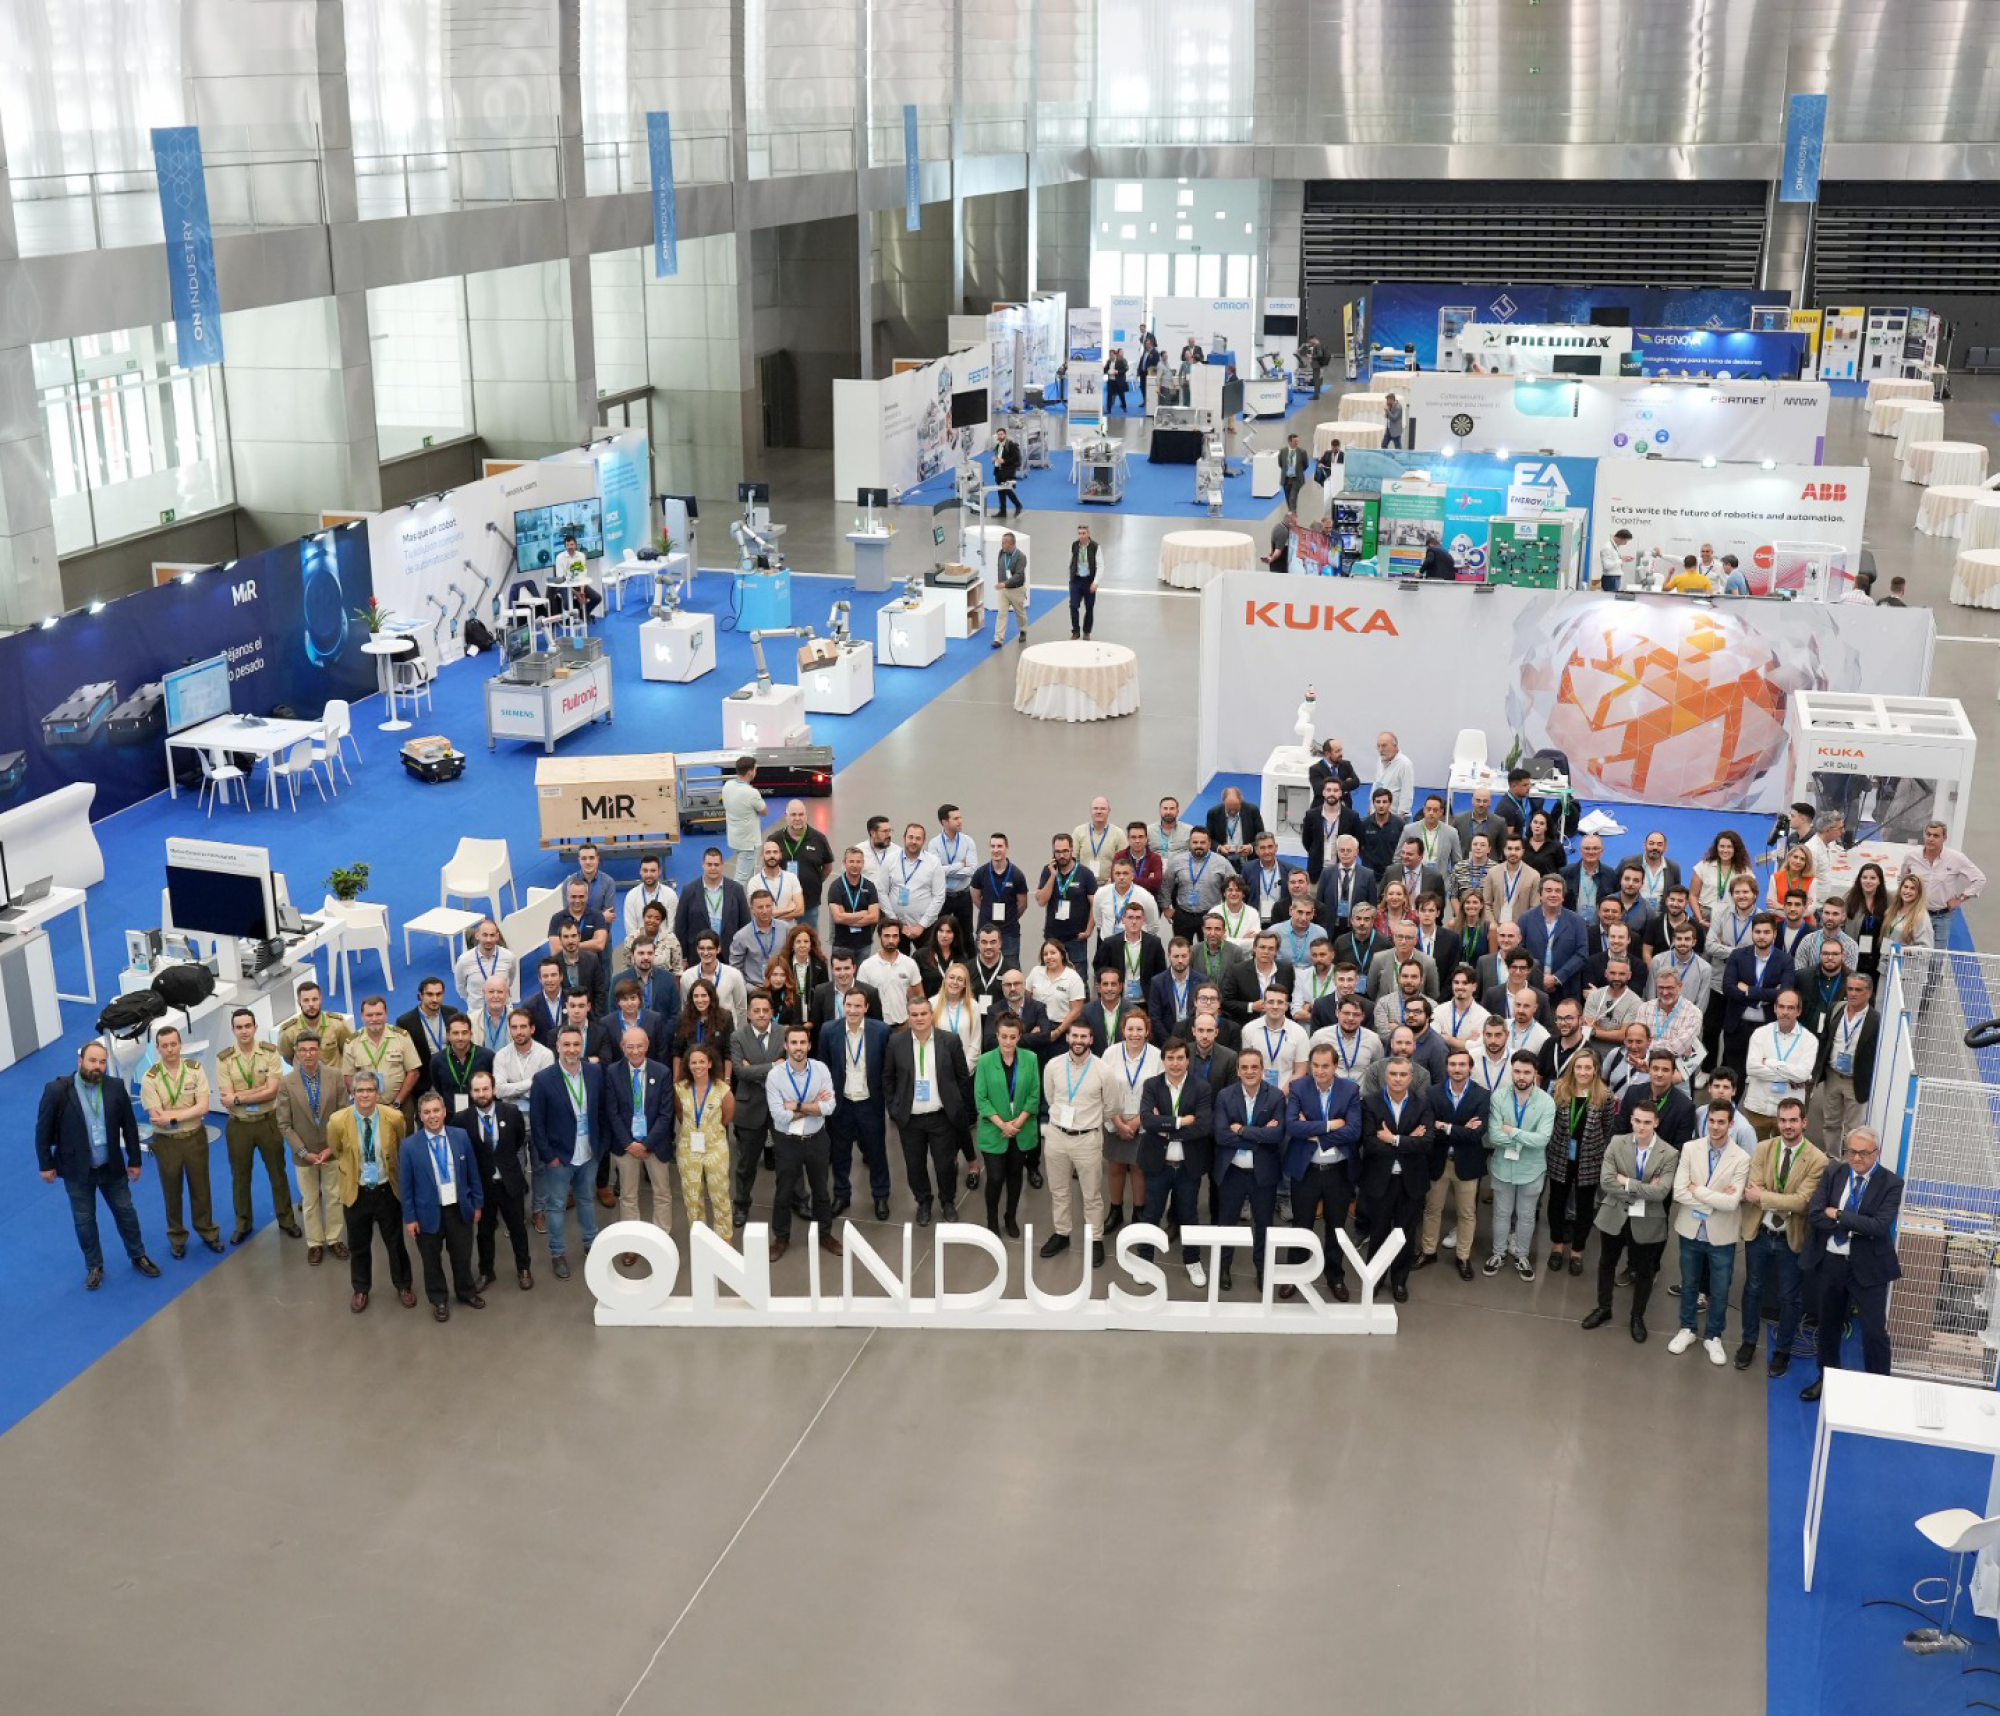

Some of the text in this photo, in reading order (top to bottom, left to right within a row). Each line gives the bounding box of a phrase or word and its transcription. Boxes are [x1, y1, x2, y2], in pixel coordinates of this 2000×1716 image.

[182, 219, 203, 341] ON INDUSTRY
[1212, 301, 1250, 310] OMRON
[1793, 315, 1819, 325] RADAR
[968, 366, 989, 386] FESTO
[1710, 396, 1766, 405] FORTINET
[1514, 462, 1571, 495] EA
[1801, 483, 1847, 502] ABB
[1610, 505, 1633, 514] Let's
[1635, 507, 1660, 516] write
[1663, 507, 1678, 517] the
[1680, 508, 1709, 518] future
[1711, 509, 1722, 518] of
[1724, 510, 1764, 520] robotics
[1766, 512, 1785, 521] and
[1245, 600, 1399, 637] KUKA
[235, 658, 265, 680] pesado
[501, 709, 534, 718] SIEMENS
[1817, 746, 1865, 758] KUKA
[1837, 761, 1858, 770] Delta
[581, 794, 636, 820] MiR
[584, 1220, 1406, 1320] ON INDUSTRY
